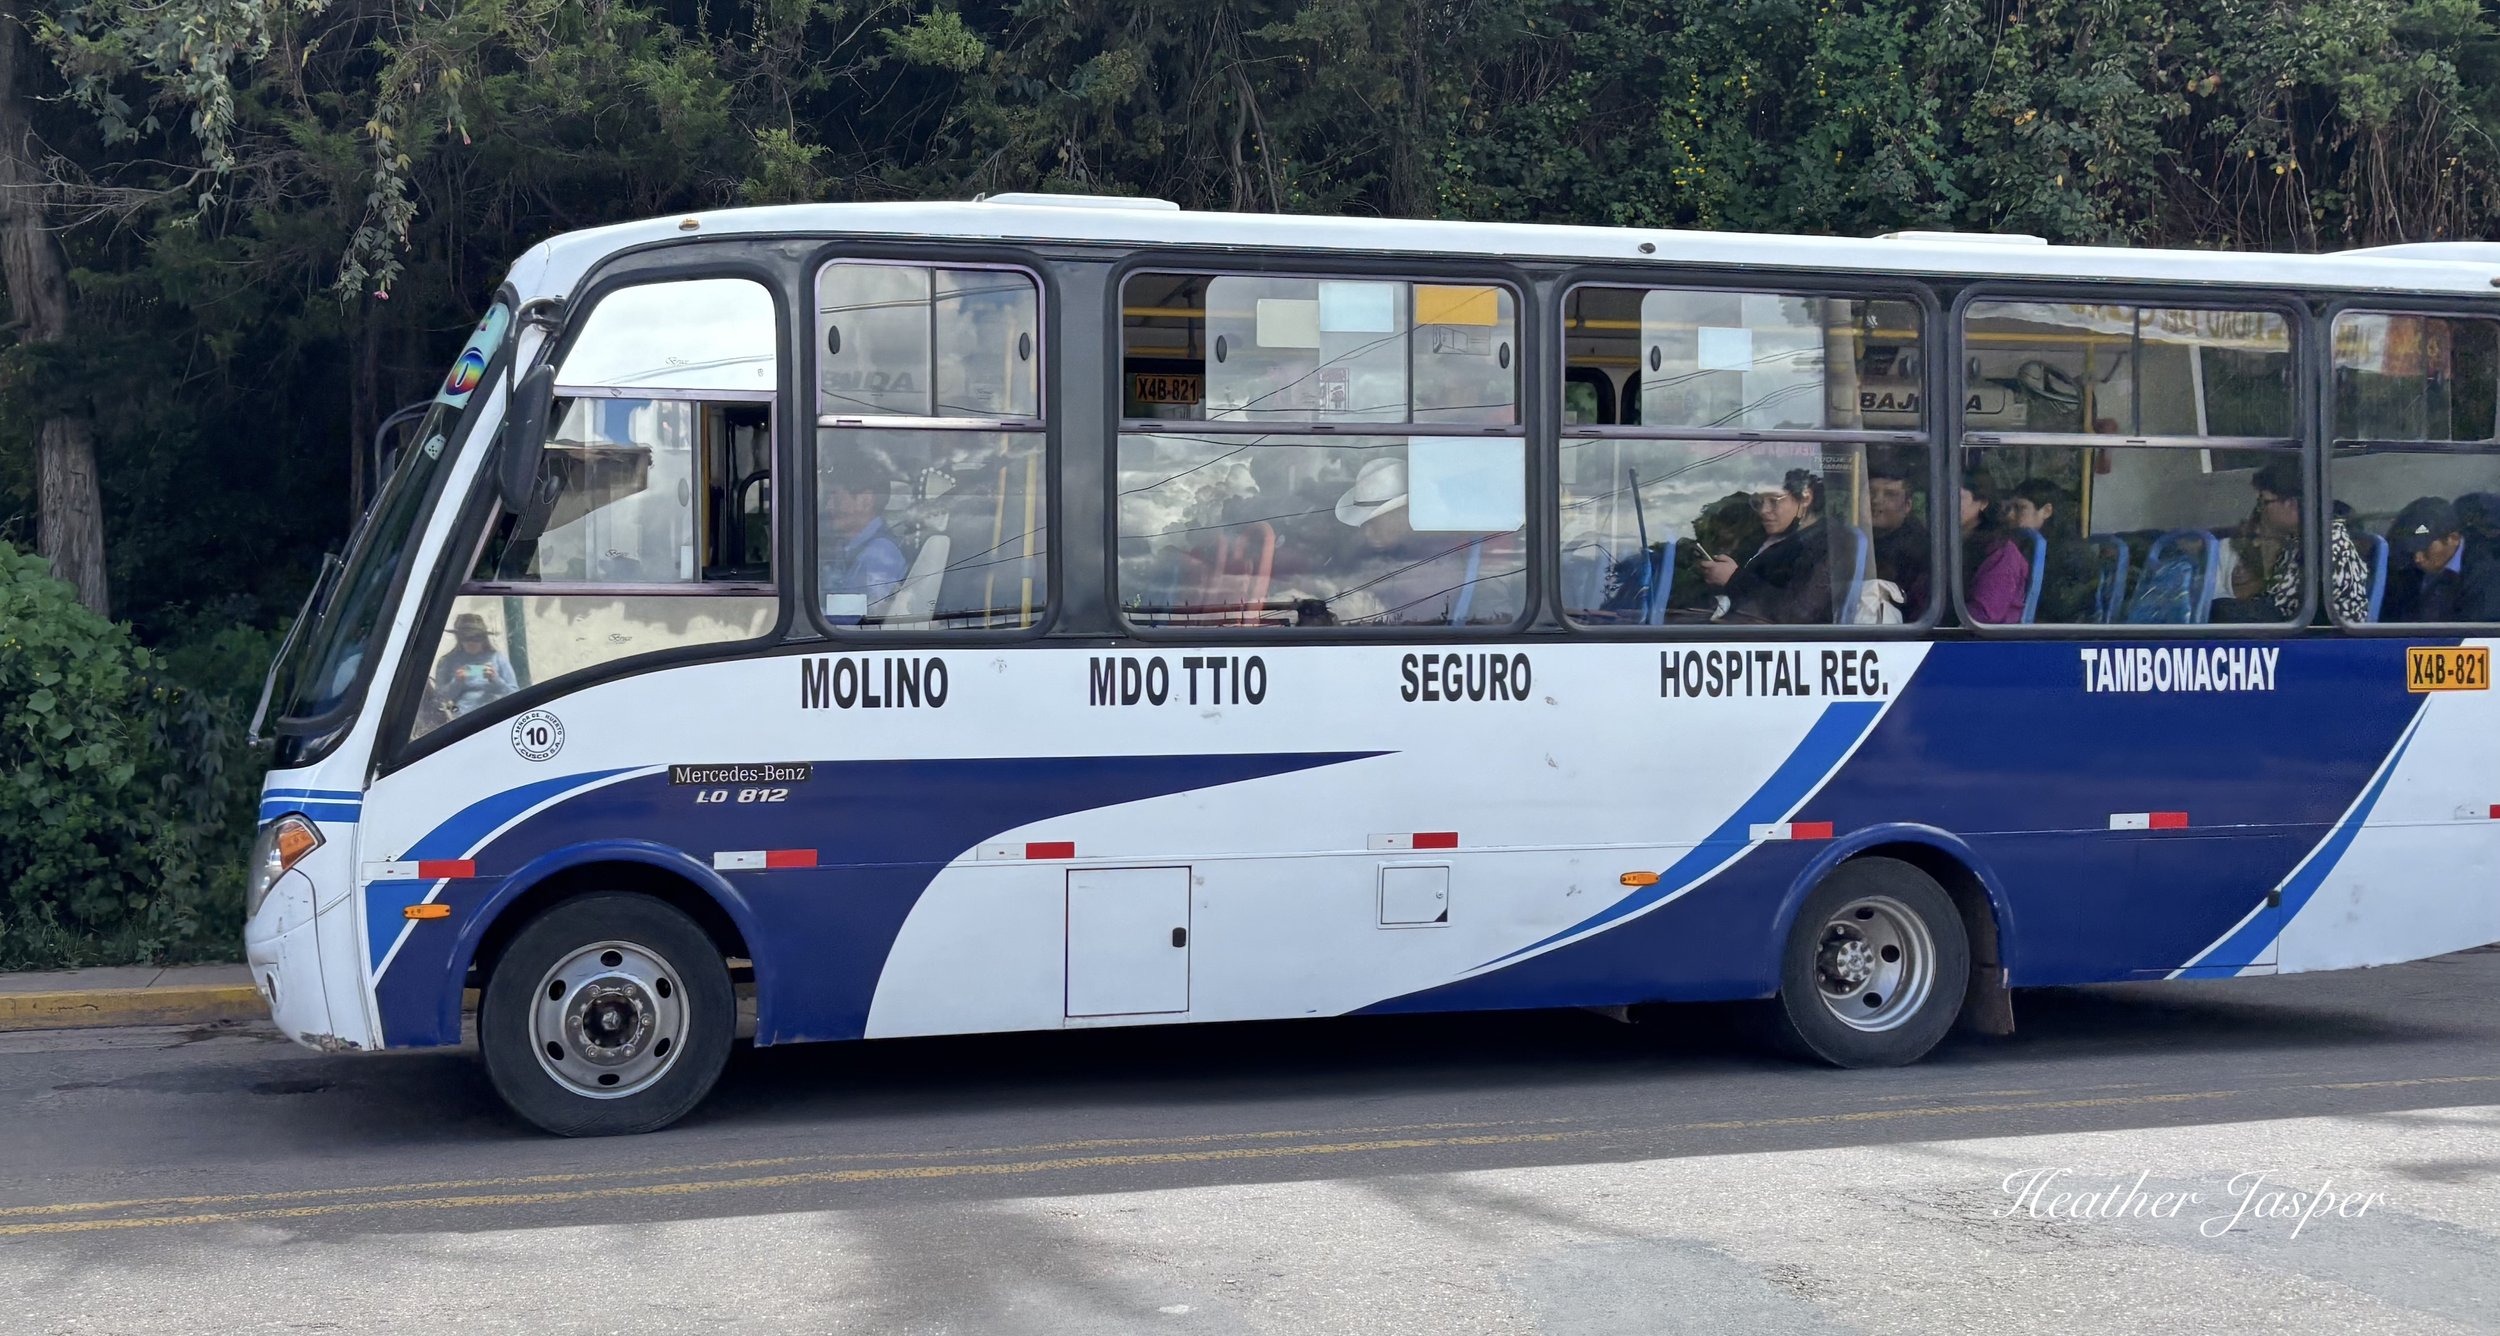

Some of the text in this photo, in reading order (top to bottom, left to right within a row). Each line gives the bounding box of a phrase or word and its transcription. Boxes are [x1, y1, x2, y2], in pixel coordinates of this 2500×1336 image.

[1137, 377, 1197, 401] X4B-821
[1860, 391, 1982, 411] BAJA
[1401, 653, 1531, 702] SEGURO
[1661, 650, 1888, 697] HOSPITAL REG.
[2081, 647, 2279, 692] TAMBOMACHAY
[2414, 652, 2487, 685] X4B-821
[801, 657, 948, 709] MOLINO
[1090, 656, 1266, 706] MDO TTIO
[526, 727, 548, 746] 10
[545, 714, 562, 735] HUERTO
[519, 748, 549, 759] CUSCO
[675, 764, 806, 783] Mercedes-Benz
[696, 787, 790, 803] LO 812
